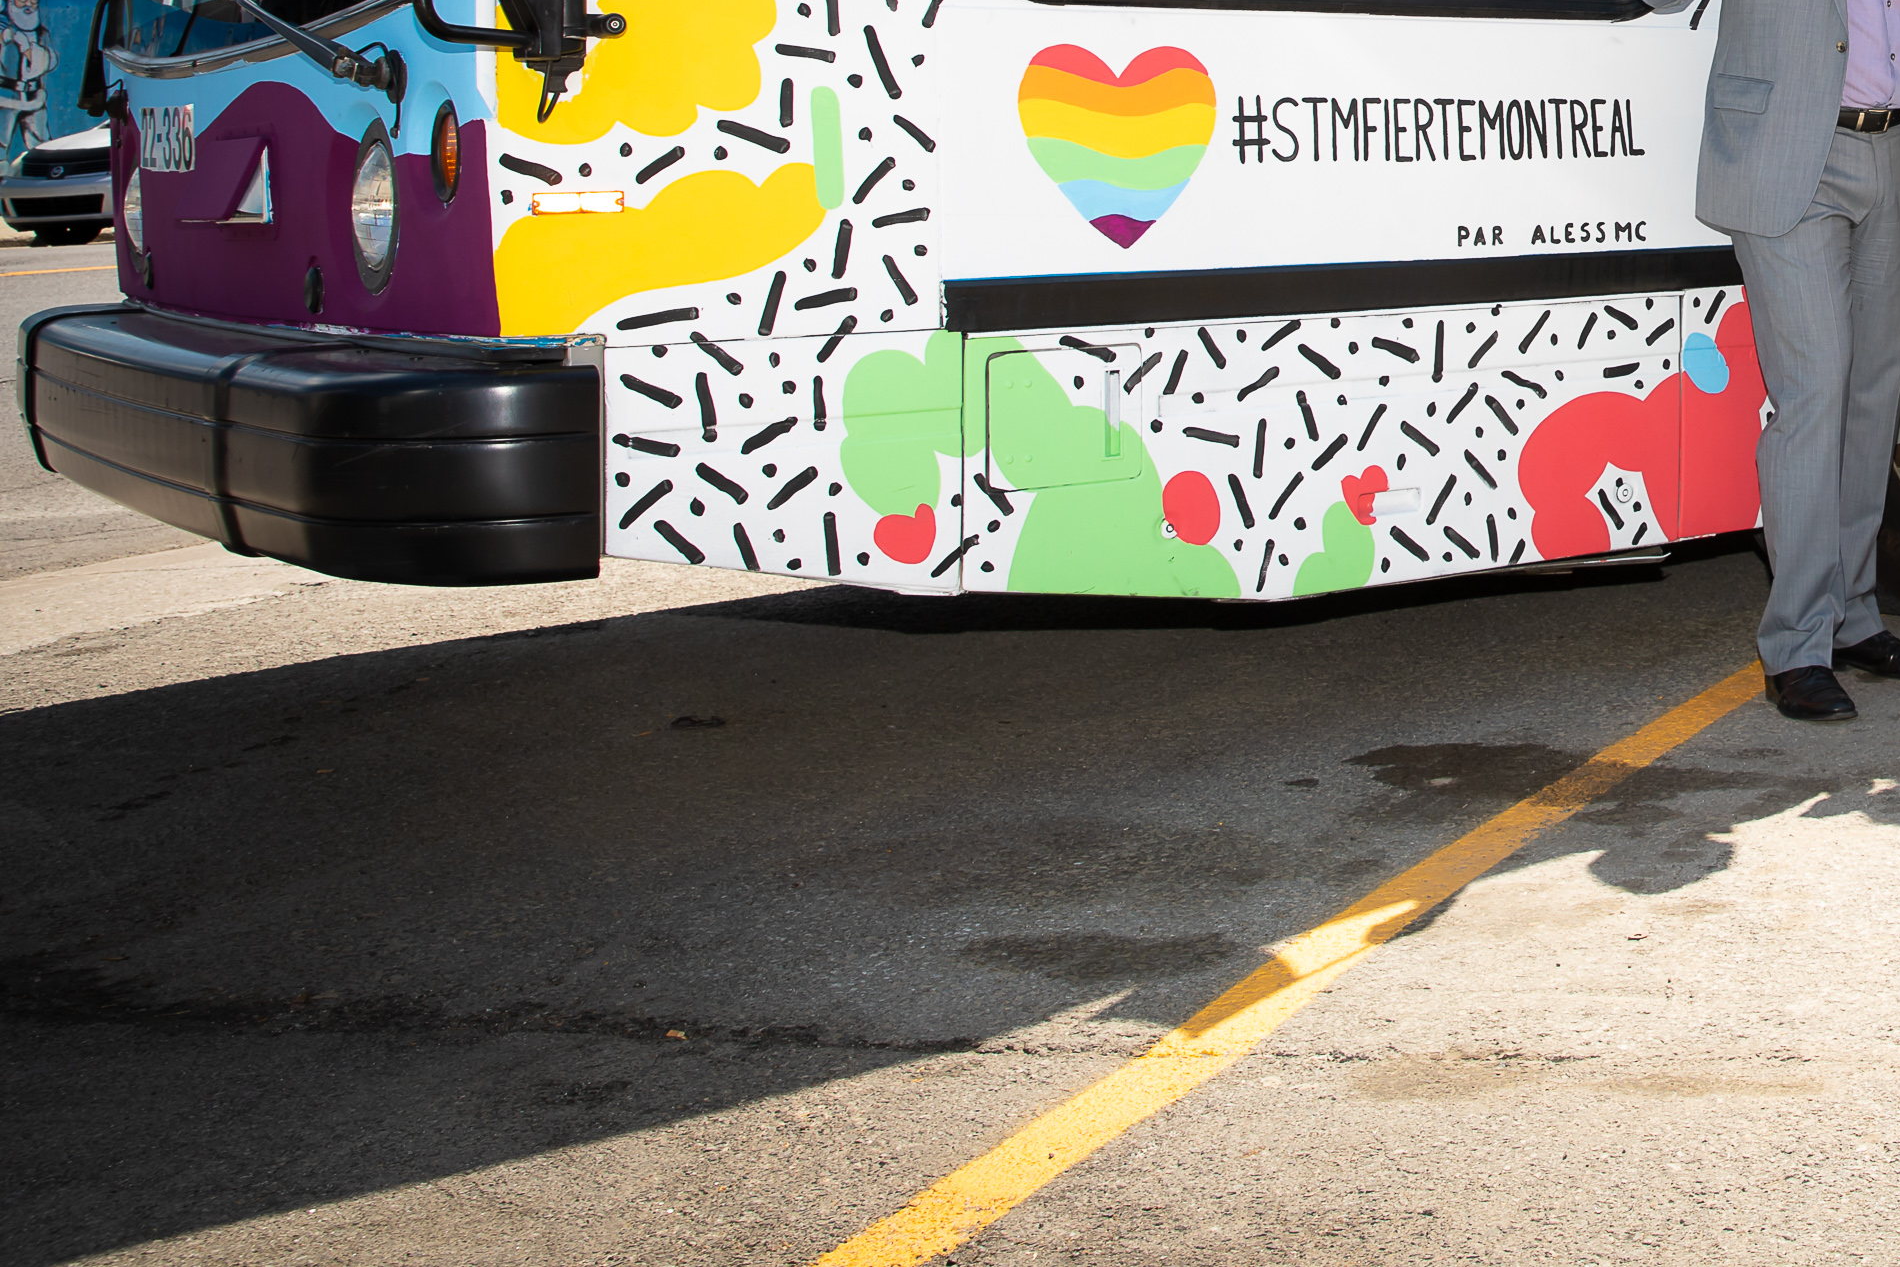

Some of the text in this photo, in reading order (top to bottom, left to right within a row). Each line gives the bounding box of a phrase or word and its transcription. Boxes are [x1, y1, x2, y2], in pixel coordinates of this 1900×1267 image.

[141, 107, 193, 170] 22-336
[1232, 95, 1645, 164] #STMFIERTEMONTREAL
[1457, 225, 1504, 247] PAR
